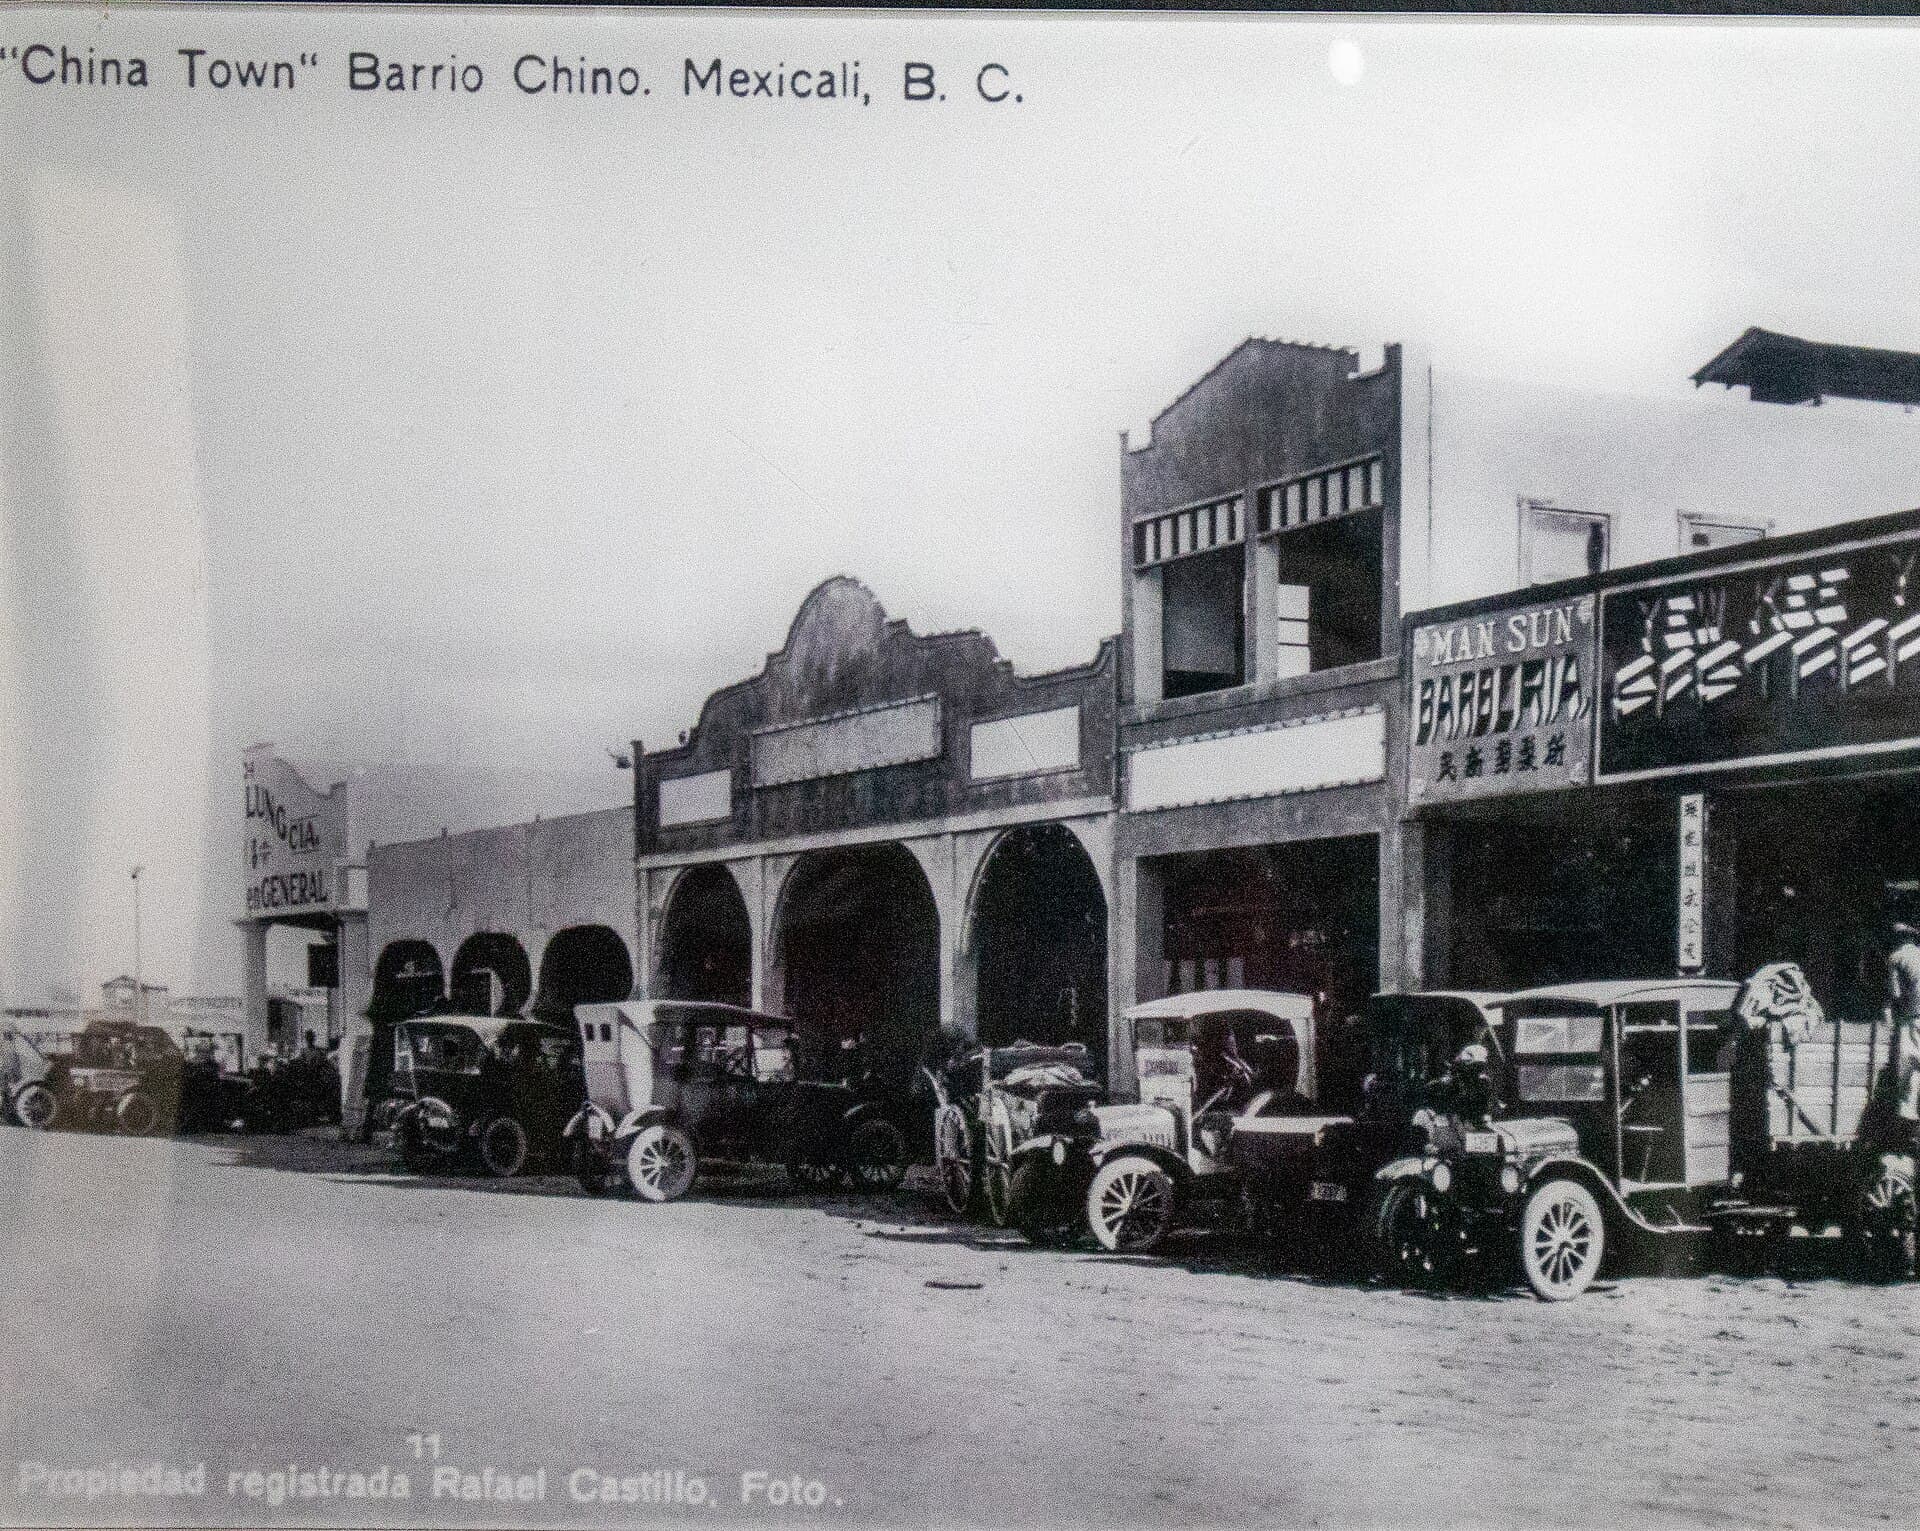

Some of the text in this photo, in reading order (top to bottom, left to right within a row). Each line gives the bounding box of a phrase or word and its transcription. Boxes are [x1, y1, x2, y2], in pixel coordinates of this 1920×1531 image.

[1431, 605, 1575, 667] MAN SUN
[245, 784, 287, 841] LUNG
[261, 869, 329, 909] GENERAL
